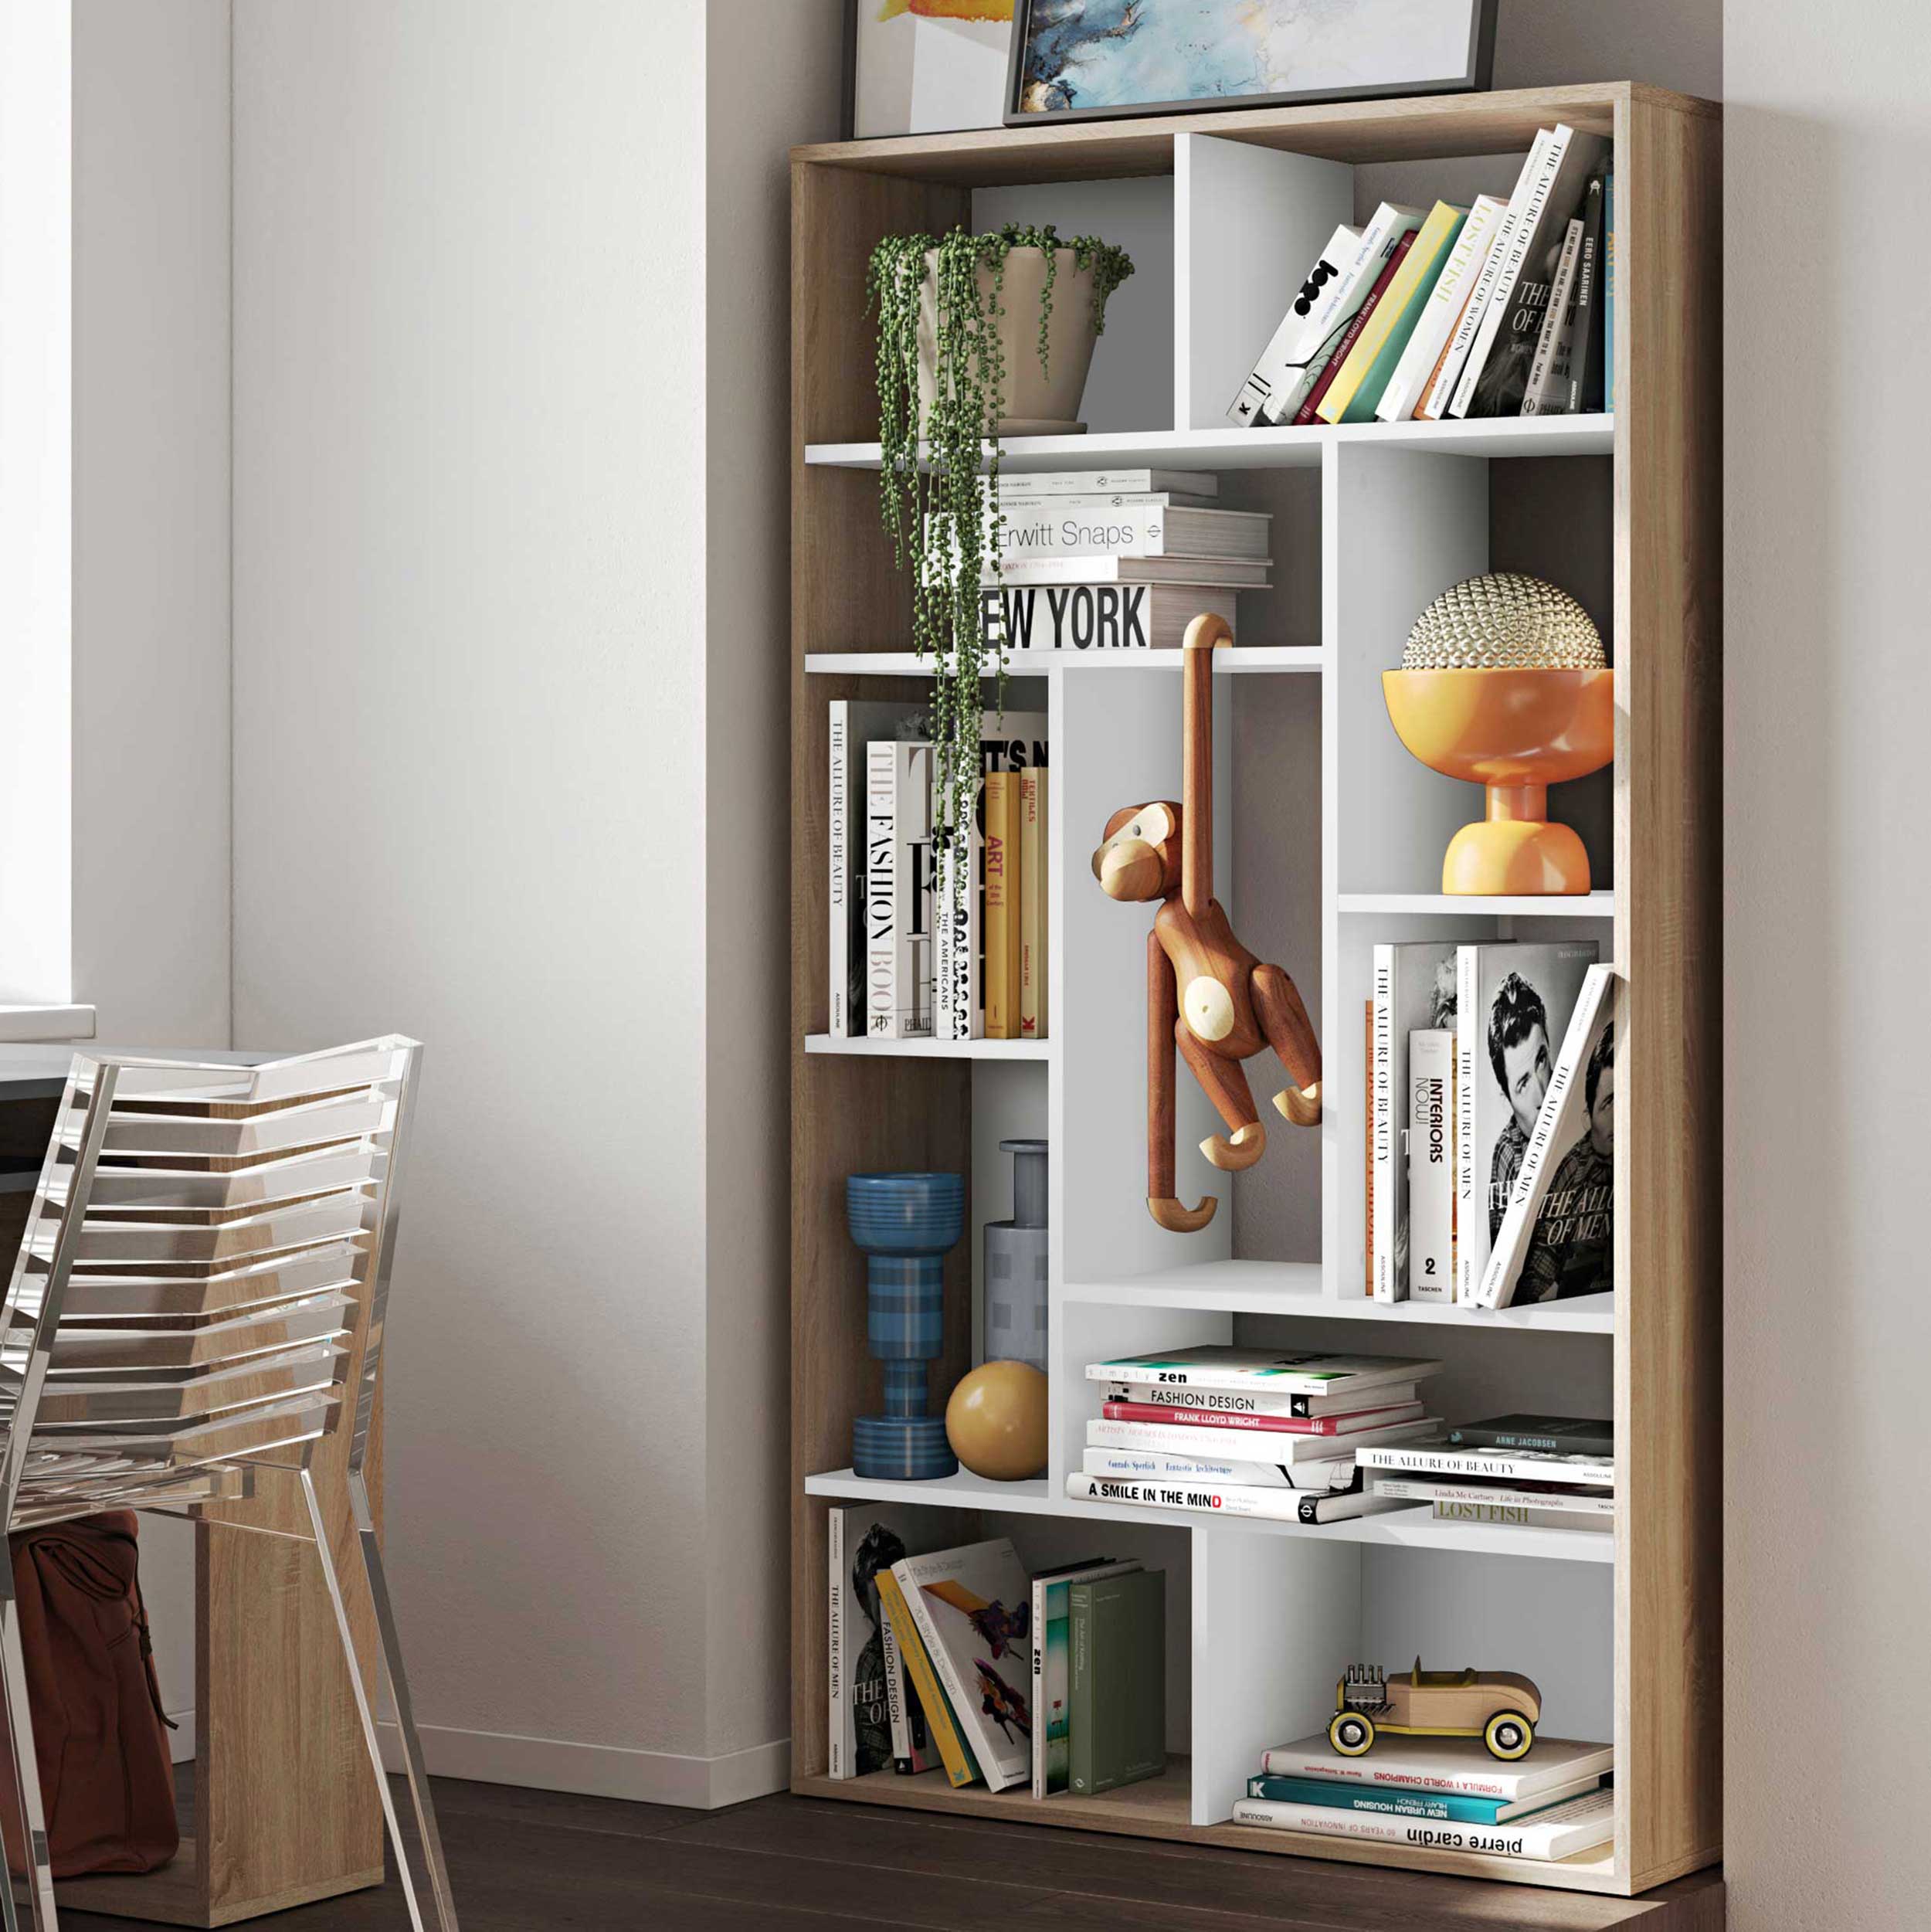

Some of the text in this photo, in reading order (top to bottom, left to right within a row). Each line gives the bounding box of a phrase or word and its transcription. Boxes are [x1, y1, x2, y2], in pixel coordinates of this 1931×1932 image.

[1543, 141, 1563, 172] THE
[1522, 172, 1551, 226] ALLURE
[1515, 227, 1531, 248] OF
[1434, 202, 1492, 303] LOST FISH
[1453, 212, 1517, 354] THE ALLURE OF WOMEN
[1492, 249, 1522, 304] BEAUTY
[1578, 236, 1594, 306] EERO SAARINEN
[1329, 292, 1377, 367] FRANK LLOYD WRIGHT
[1512, 309, 1537, 331] OF
[1061, 521, 1134, 549] Snaps
[958, 586, 1146, 650] EW YORK
[870, 745, 893, 806] THE
[833, 720, 842, 907] THE ALLURE OF BEAUTY
[988, 836, 1003, 876] ART
[870, 816, 893, 939] FASHION
[1377, 965, 1388, 1163] THE ALLURE OF BEAUTY
[1415, 1077, 1429, 1124] NOW!
[1430, 1078, 1442, 1163] INTERIORS
[1461, 1048, 1470, 1199] THE ALLURE OF MEN
[1513, 1063, 1570, 1206] THE ALLURE OF MEN
[1537, 1186, 1614, 1219] THE ALL
[1547, 1214, 1612, 1245] OF MEN
[1425, 1258, 1435, 1274] 2
[1159, 1372, 1187, 1384] zen
[1151, 1390, 1255, 1411] FASHION DESIGN
[1174, 1412, 1260, 1427] FRANK LLOYD WRIGHT
[1496, 1436, 1557, 1448] ARNE JACOBSEN
[1372, 1454, 1515, 1474] THE ALLURE OF BEAUTY
[1089, 1482, 1098, 1496] A
[1101, 1483, 1139, 1499] SMILE
[1144, 1488, 1156, 1502] IN
[1160, 1490, 1183, 1504] THE
[1187, 1493, 1221, 1508] MIND
[1435, 1489, 1455, 1498] Linda
[1468, 1492, 1495, 1502] Cartney
[1522, 1496, 1564, 1507] Photographs
[1439, 1501, 1529, 1523] LOST FISH
[832, 1655, 839, 1672] OF
[883, 1621, 900, 1724] FASHION DESIGN
[1251, 1781, 1265, 1798] K
[1374, 1772, 1422, 1784] CHAMPIONS
[1424, 1778, 1454, 1788] WORLD
[1462, 1783, 1502, 1794] FORMULA
[1240, 1811, 1273, 1822] ASSOULINE
[1353, 1799, 1447, 1818] NEW URBAN HOUSING
[1397, 1798, 1447, 1809] HILARY FRENCH
[1301, 1818, 1346, 1830] INNOVATION
[1360, 1826, 1384, 1835] YEARS
[1407, 1828, 1523, 1856] pierre cardin
